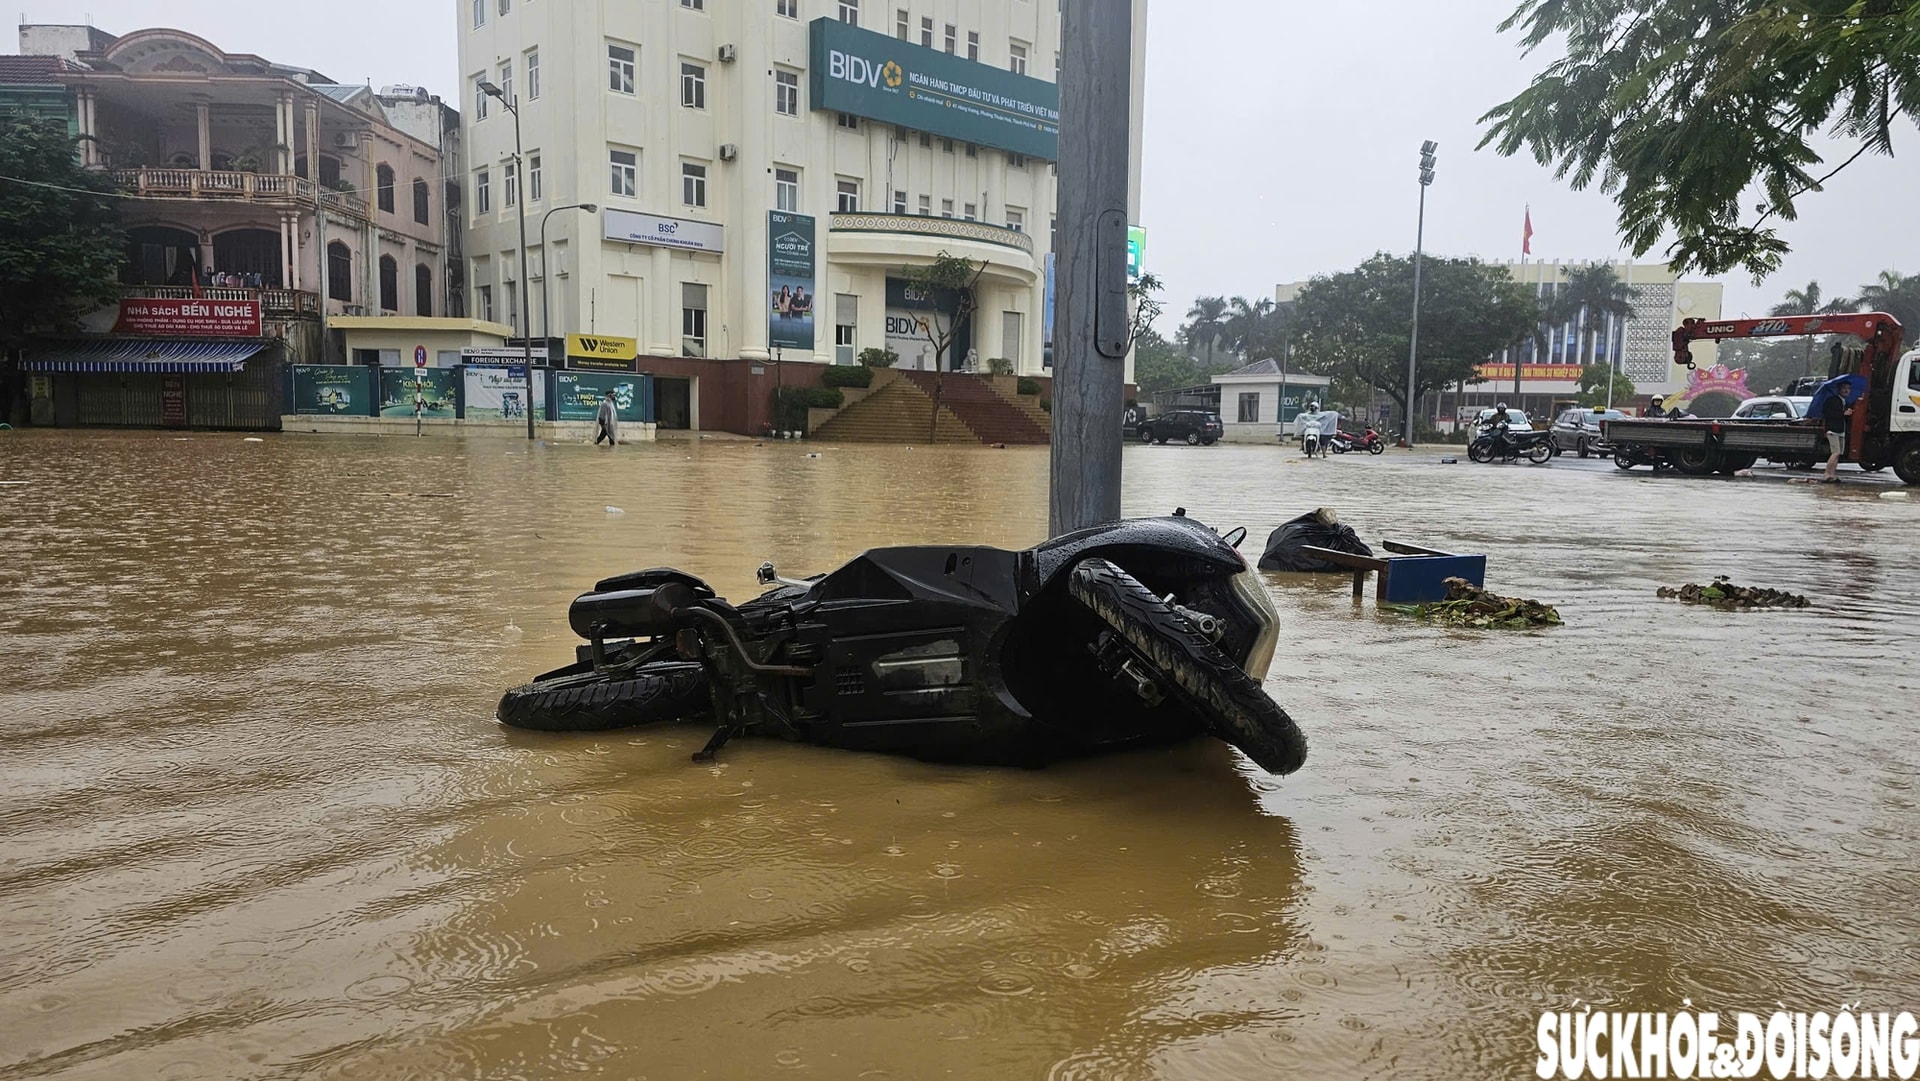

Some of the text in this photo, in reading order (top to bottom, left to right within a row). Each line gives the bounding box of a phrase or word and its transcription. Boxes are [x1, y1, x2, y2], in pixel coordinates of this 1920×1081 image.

[830, 50, 883, 88] BIDV
[910, 72, 928, 86] NGÂN
[930, 77, 948, 92] HÀNG
[950, 82, 968, 95] TMCP
[968, 87, 981, 100] ĐẦU
[982, 92, 991, 102] TƯ
[1001, 97, 1016, 109] PHÁT
[1017, 101, 1034, 114] TRIỂN
[1034, 106, 1047, 117] VIỆT
[658, 224, 675, 233] BSC
[127, 301, 252, 317] NHÀ SÁCH BẾN NGHÉ
[886, 317, 918, 335] BIDV
[1706, 325, 1734, 334] UNIC
[600, 340, 625, 348] Western
[1281, 397, 1295, 406] IDV
